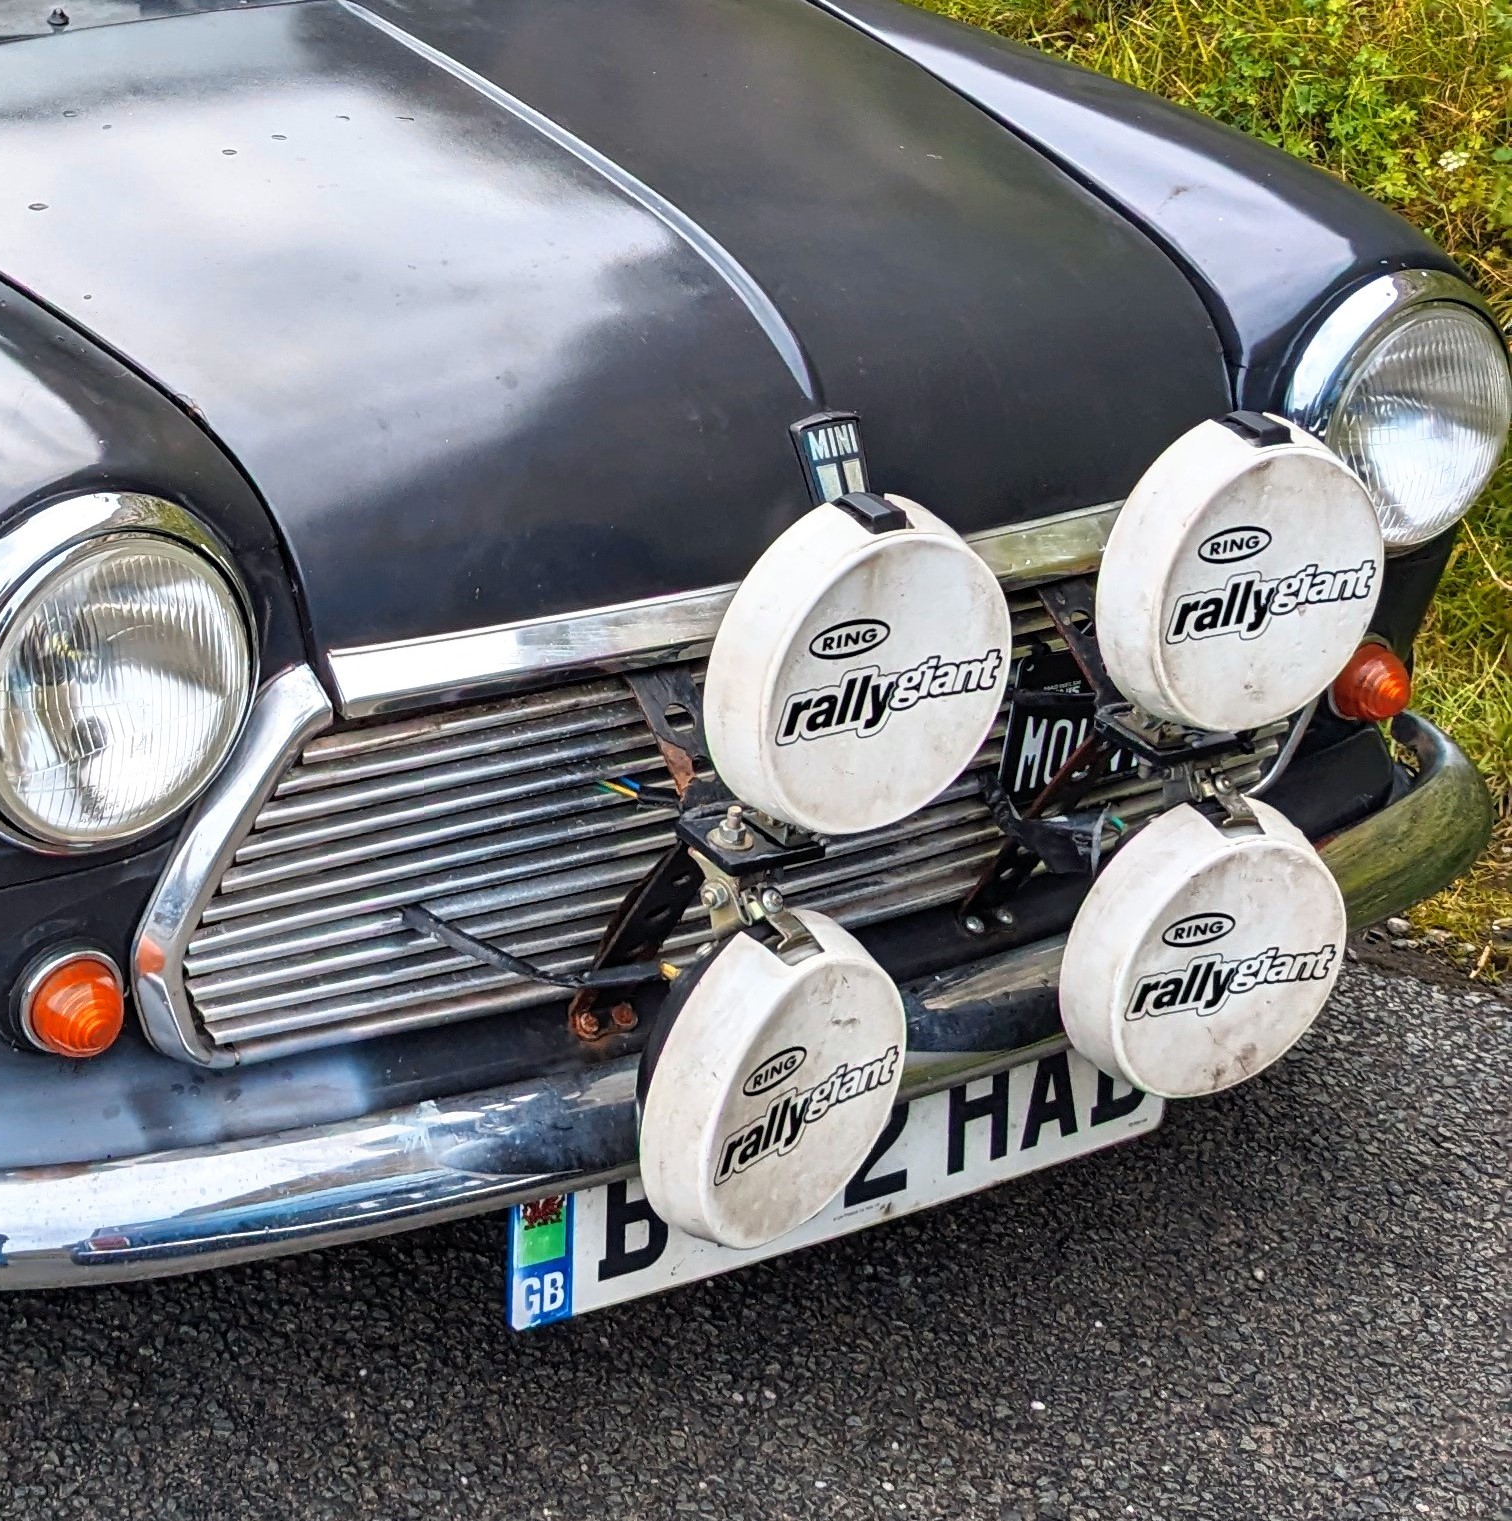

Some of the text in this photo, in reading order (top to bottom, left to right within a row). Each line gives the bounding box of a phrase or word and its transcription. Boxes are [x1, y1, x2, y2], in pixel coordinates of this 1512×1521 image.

[807, 423, 859, 461] MINI
[1208, 534, 1261, 557] RING
[1171, 560, 1376, 638] rallygiant
[820, 627, 879, 652] RING
[781, 649, 1001, 738] rallygiant
[1172, 920, 1225, 941] RING
[1131, 944, 1336, 1015] rallygiant
[751, 1054, 798, 1090] RING
[719, 1045, 900, 1178] rallygiant
[519, 1270, 565, 1315] GB
